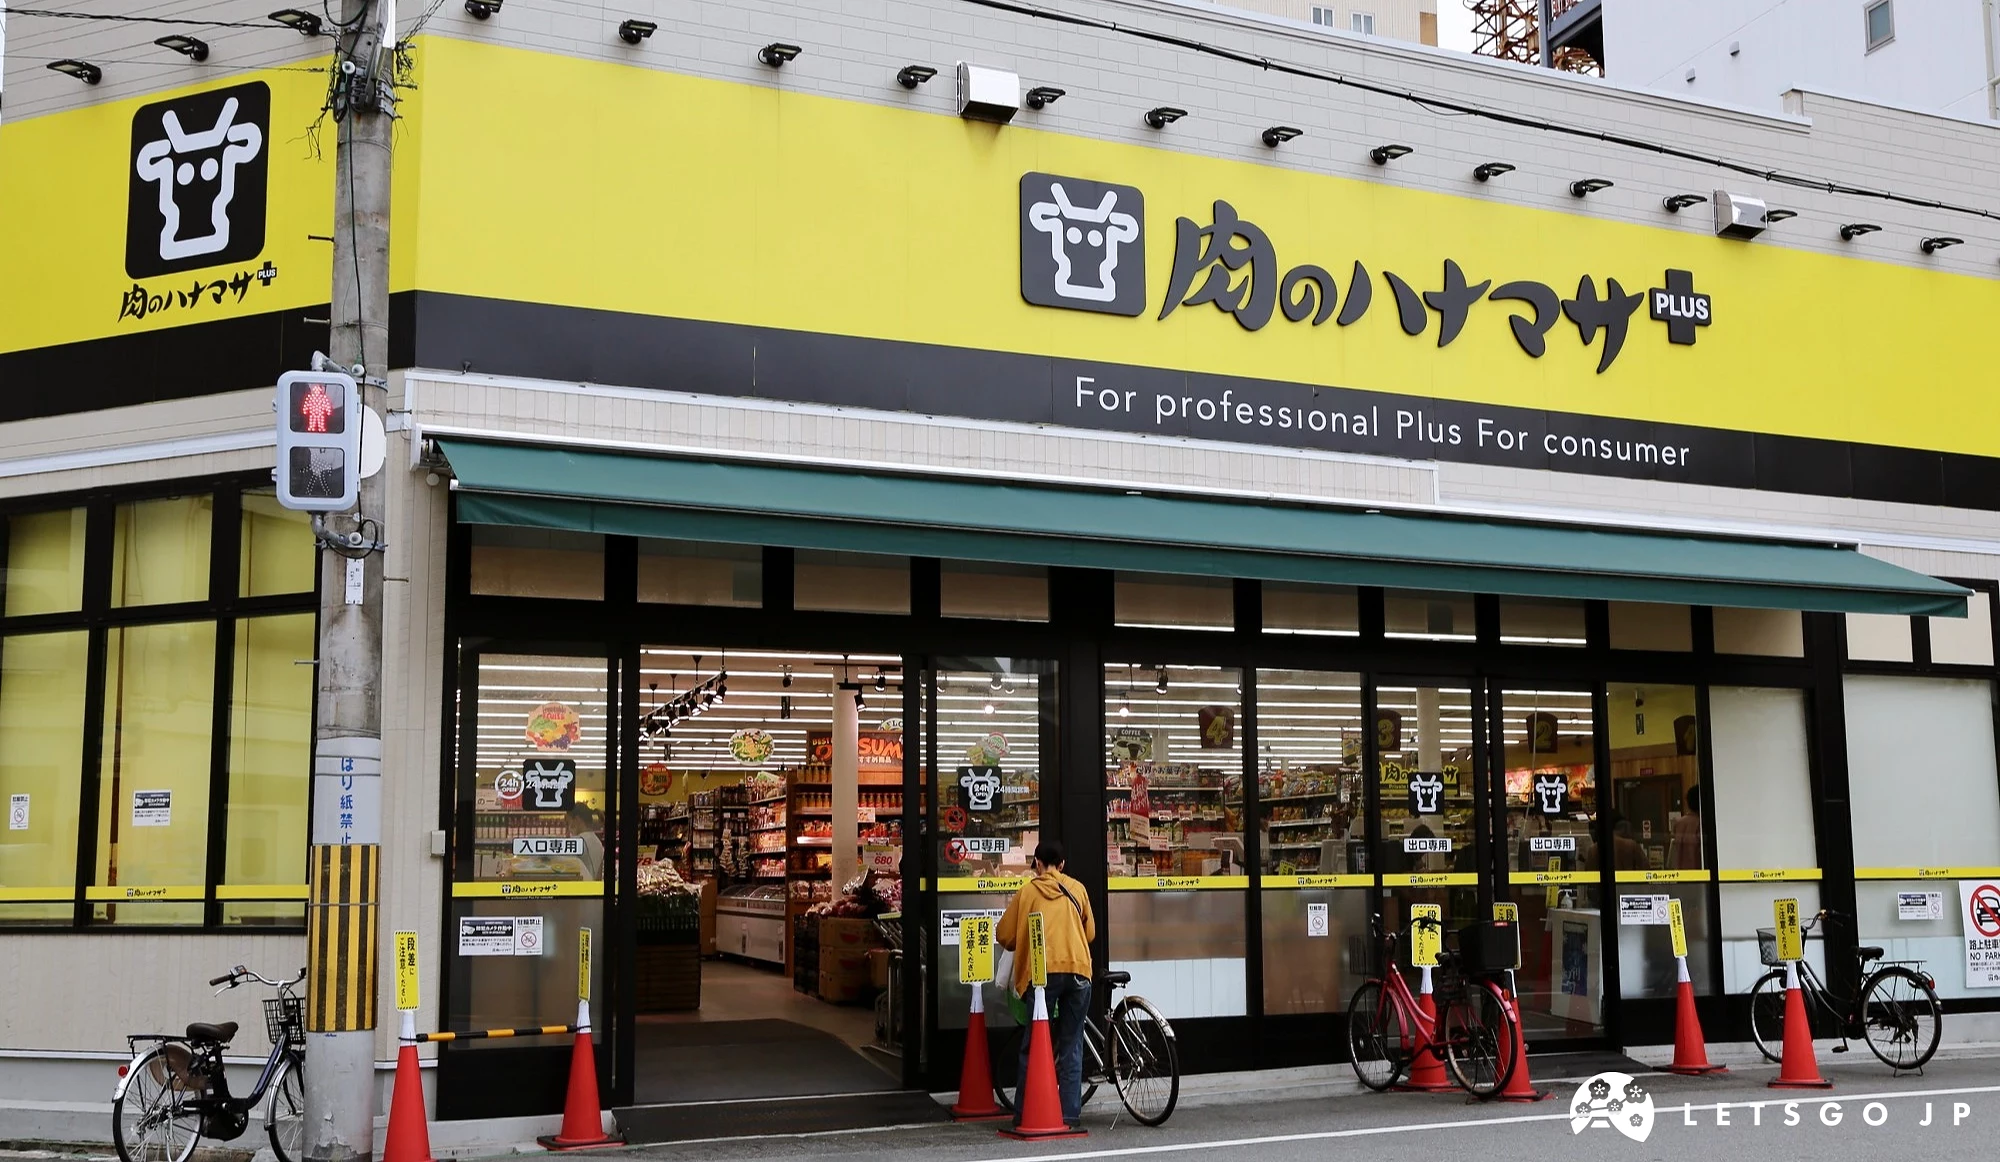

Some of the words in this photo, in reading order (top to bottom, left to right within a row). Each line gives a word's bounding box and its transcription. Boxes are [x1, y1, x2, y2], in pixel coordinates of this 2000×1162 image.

[258, 269, 276, 279] PLUS
[1158, 200, 1645, 375] 肉のハナマサ
[117, 270, 255, 323] 肉のハナマサ
[1656, 293, 1709, 321] PLUS
[1075, 375, 1137, 412] For
[1156, 387, 1379, 437] professional
[1396, 410, 1462, 446] Plus
[1477, 420, 1529, 452] For
[1543, 435, 1692, 468] consumer
[1121, 728, 1141, 736] COFFEE
[1206, 715, 1228, 745] 4
[1378, 719, 1394, 748] 3
[500, 778, 519, 788] 24h
[340, 756, 354, 844] はり紙禁止
[519, 840, 578, 854] 入口専用
[1408, 839, 1448, 851] 出口専用
[1534, 838, 1572, 850] 出口専用
[874, 856, 893, 865] 680
[1778, 903, 1789, 957] ご注意ください
[1786, 902, 1797, 934] 段差に
[965, 921, 976, 979] ご注意ください
[977, 921, 990, 954] 段差に
[1969, 939, 2000, 950] 路上駐車
[407, 936, 416, 976] 段差に
[1970, 952, 1981, 961] NO
